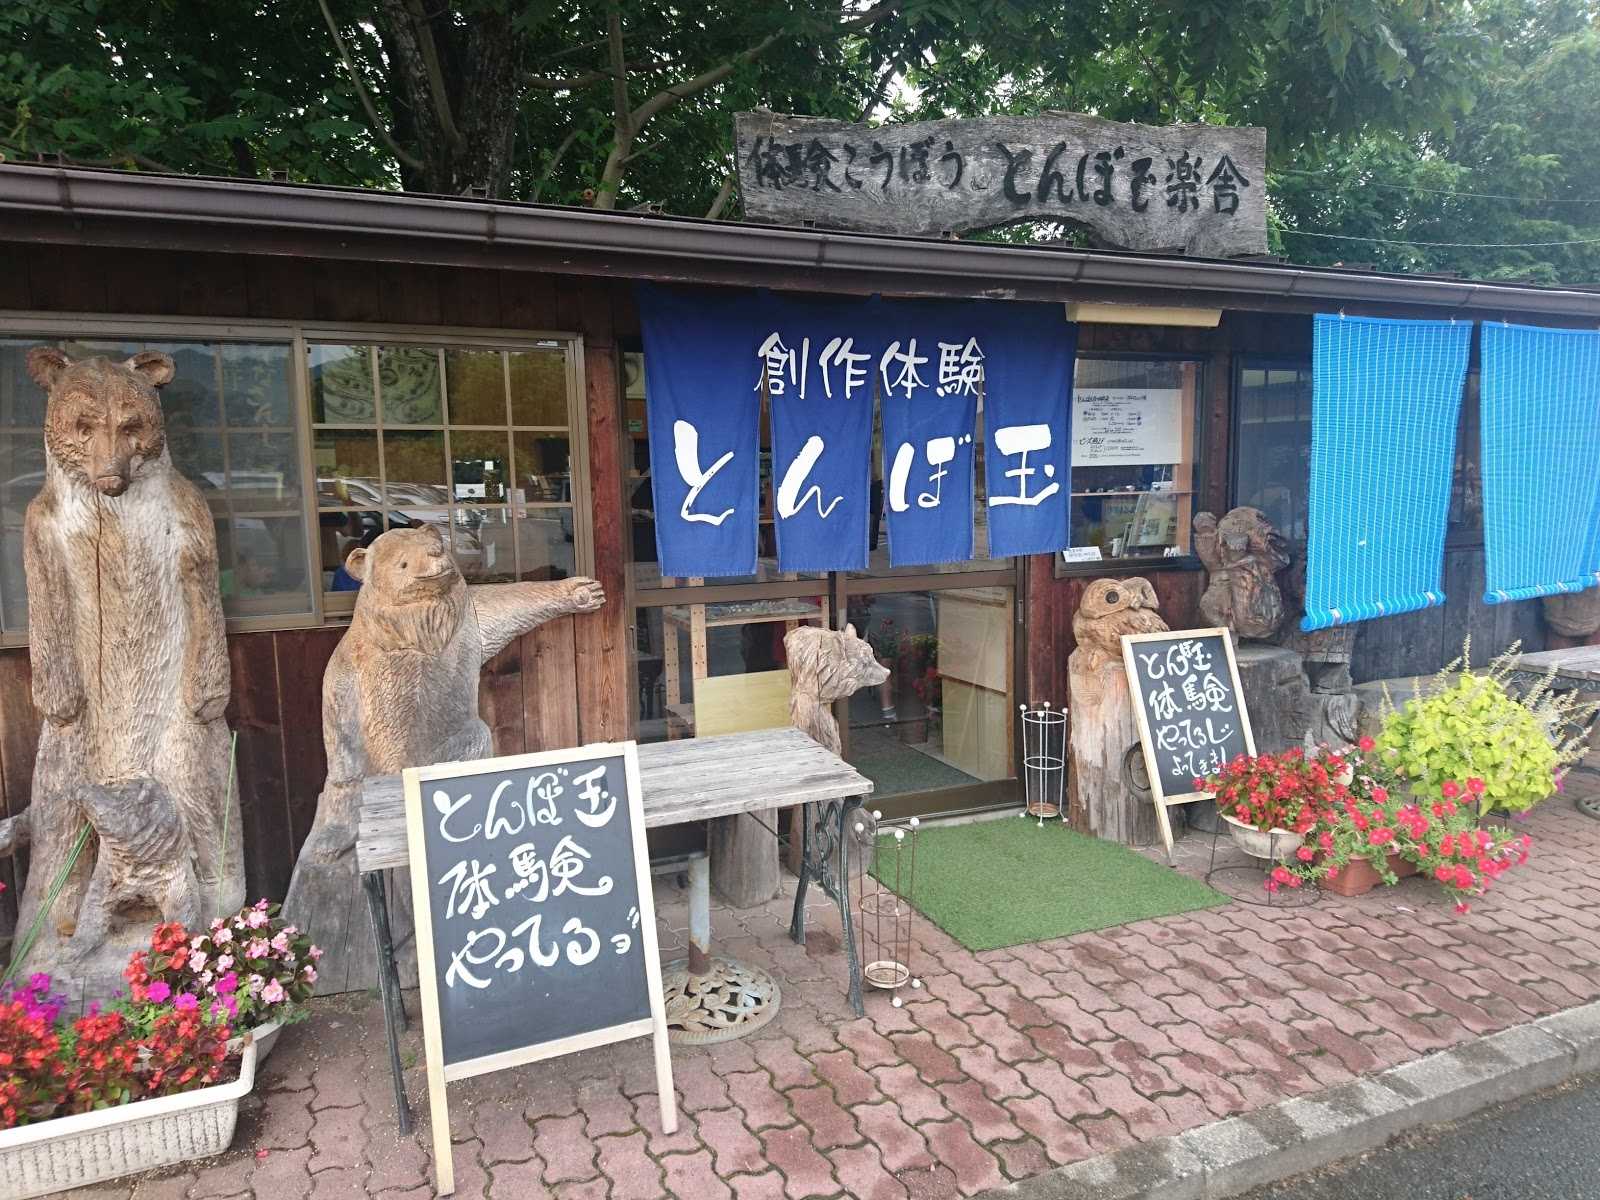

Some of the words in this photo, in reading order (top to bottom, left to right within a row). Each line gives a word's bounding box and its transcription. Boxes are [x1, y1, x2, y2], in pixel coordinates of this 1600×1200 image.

[754, 332, 986, 399] 創作体験
[673, 419, 1060, 526] とんぼ玉
[1148, 672, 1233, 721] 体験
[432, 765, 617, 843] とんぼ玉
[438, 834, 614, 920] 体験
